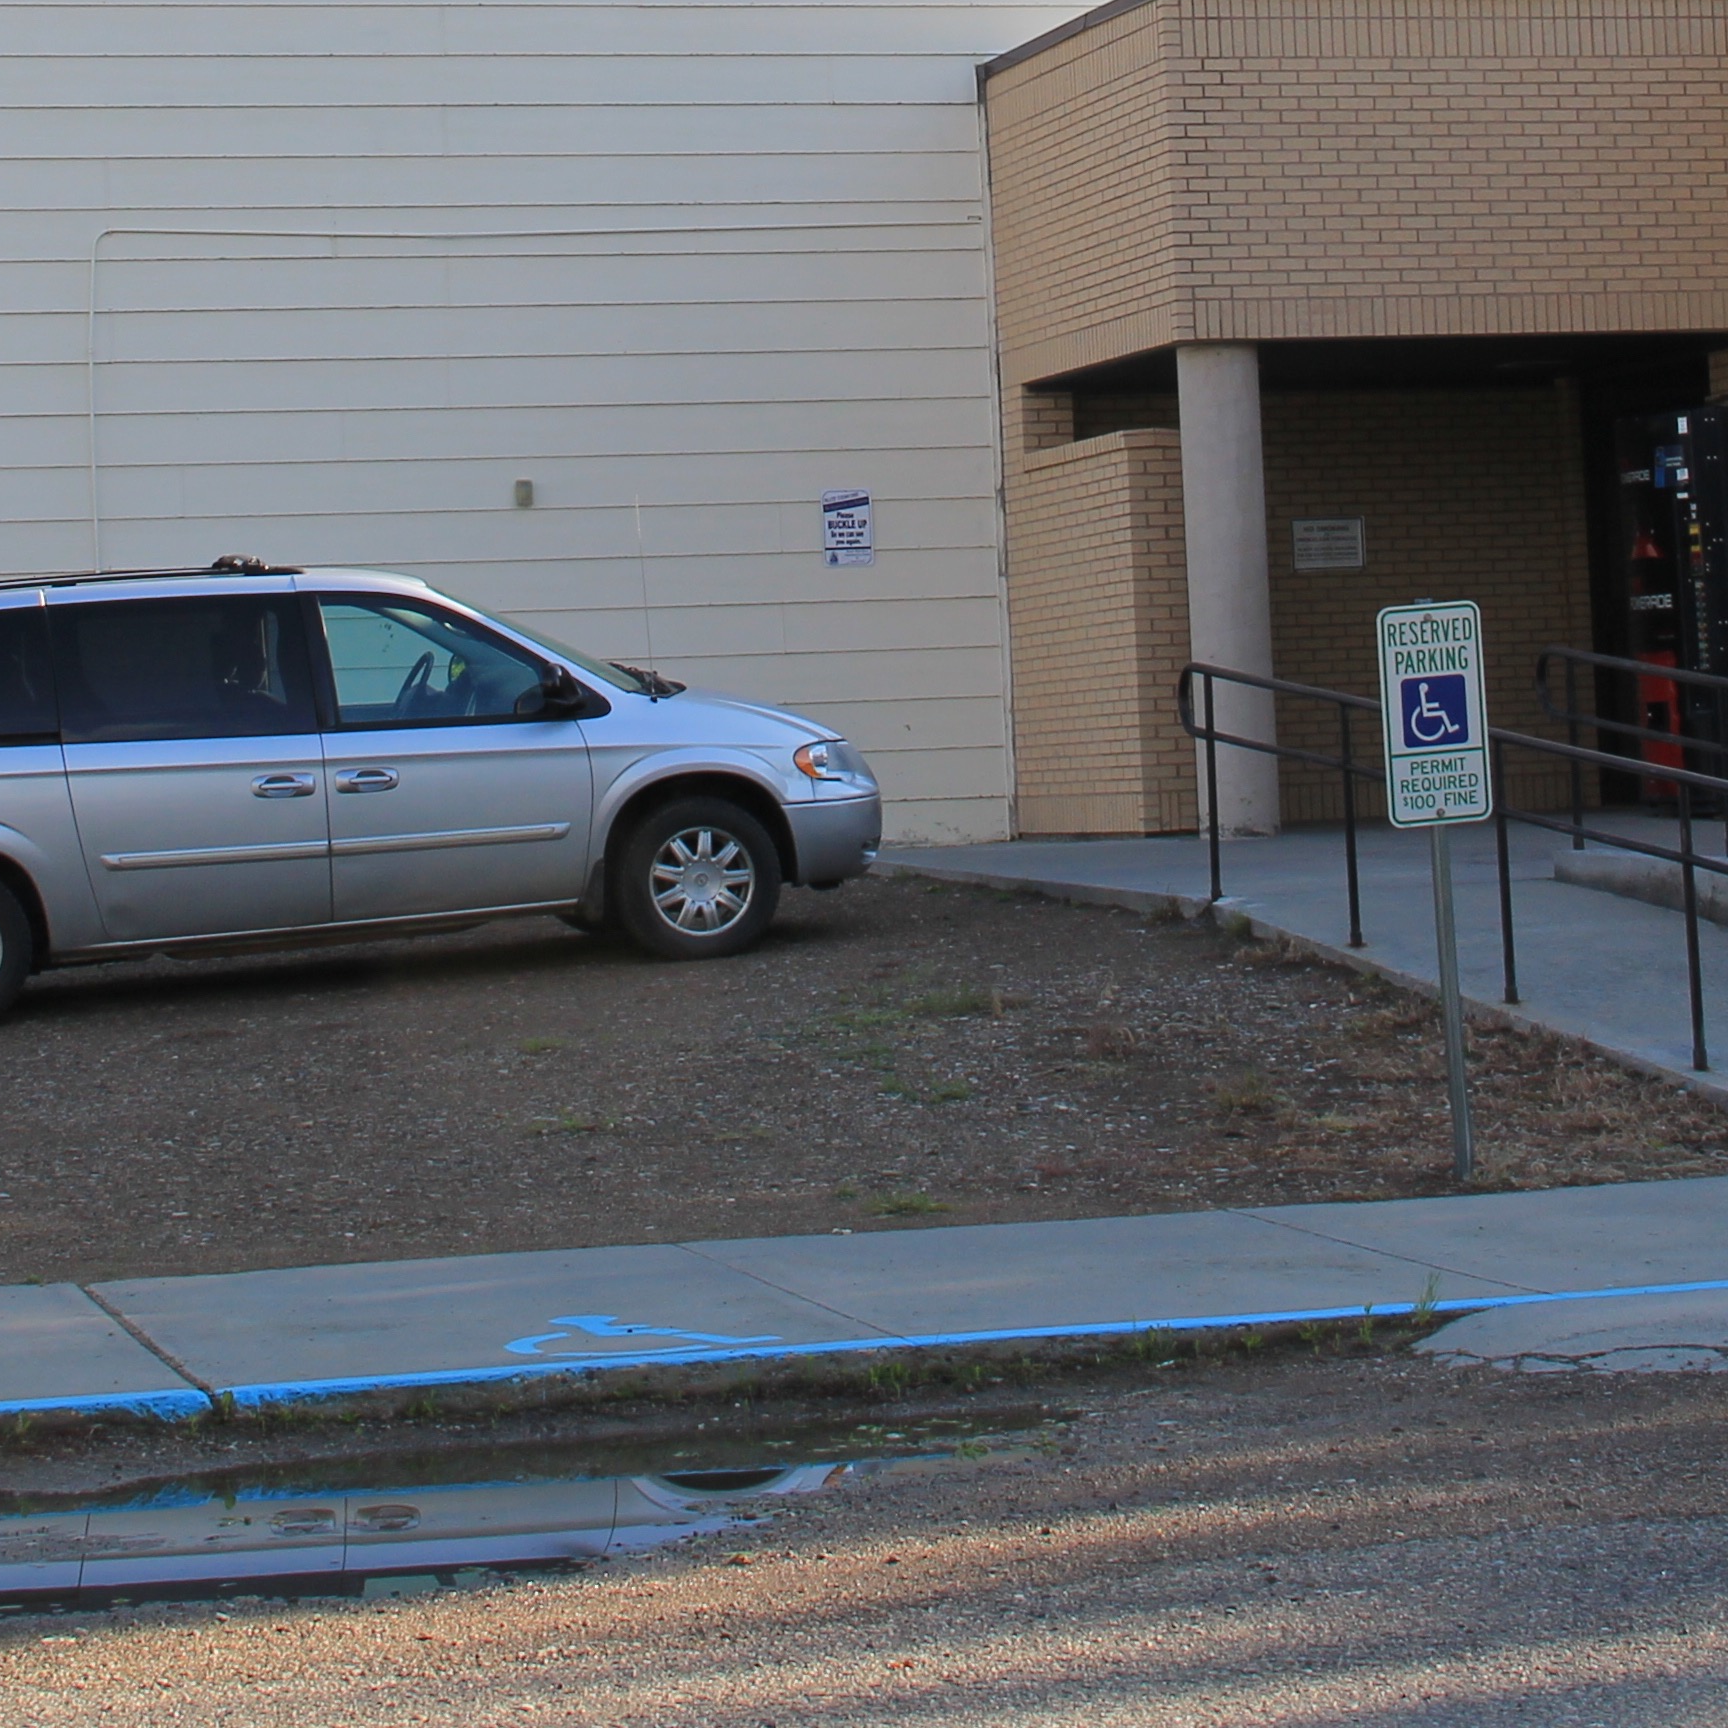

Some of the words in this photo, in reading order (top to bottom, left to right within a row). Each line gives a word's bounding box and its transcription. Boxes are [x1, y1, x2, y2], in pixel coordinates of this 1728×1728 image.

[828, 520, 856, 529] BUCKLE
[857, 519, 867, 529] UP
[1387, 617, 1472, 647] RESERVED
[1395, 645, 1469, 675] PARKING
[1410, 757, 1466, 776] PERMIT
[1400, 773, 1479, 794] REQUIRED
[1403, 793, 1436, 810] $100
[1444, 790, 1479, 807] FINE
